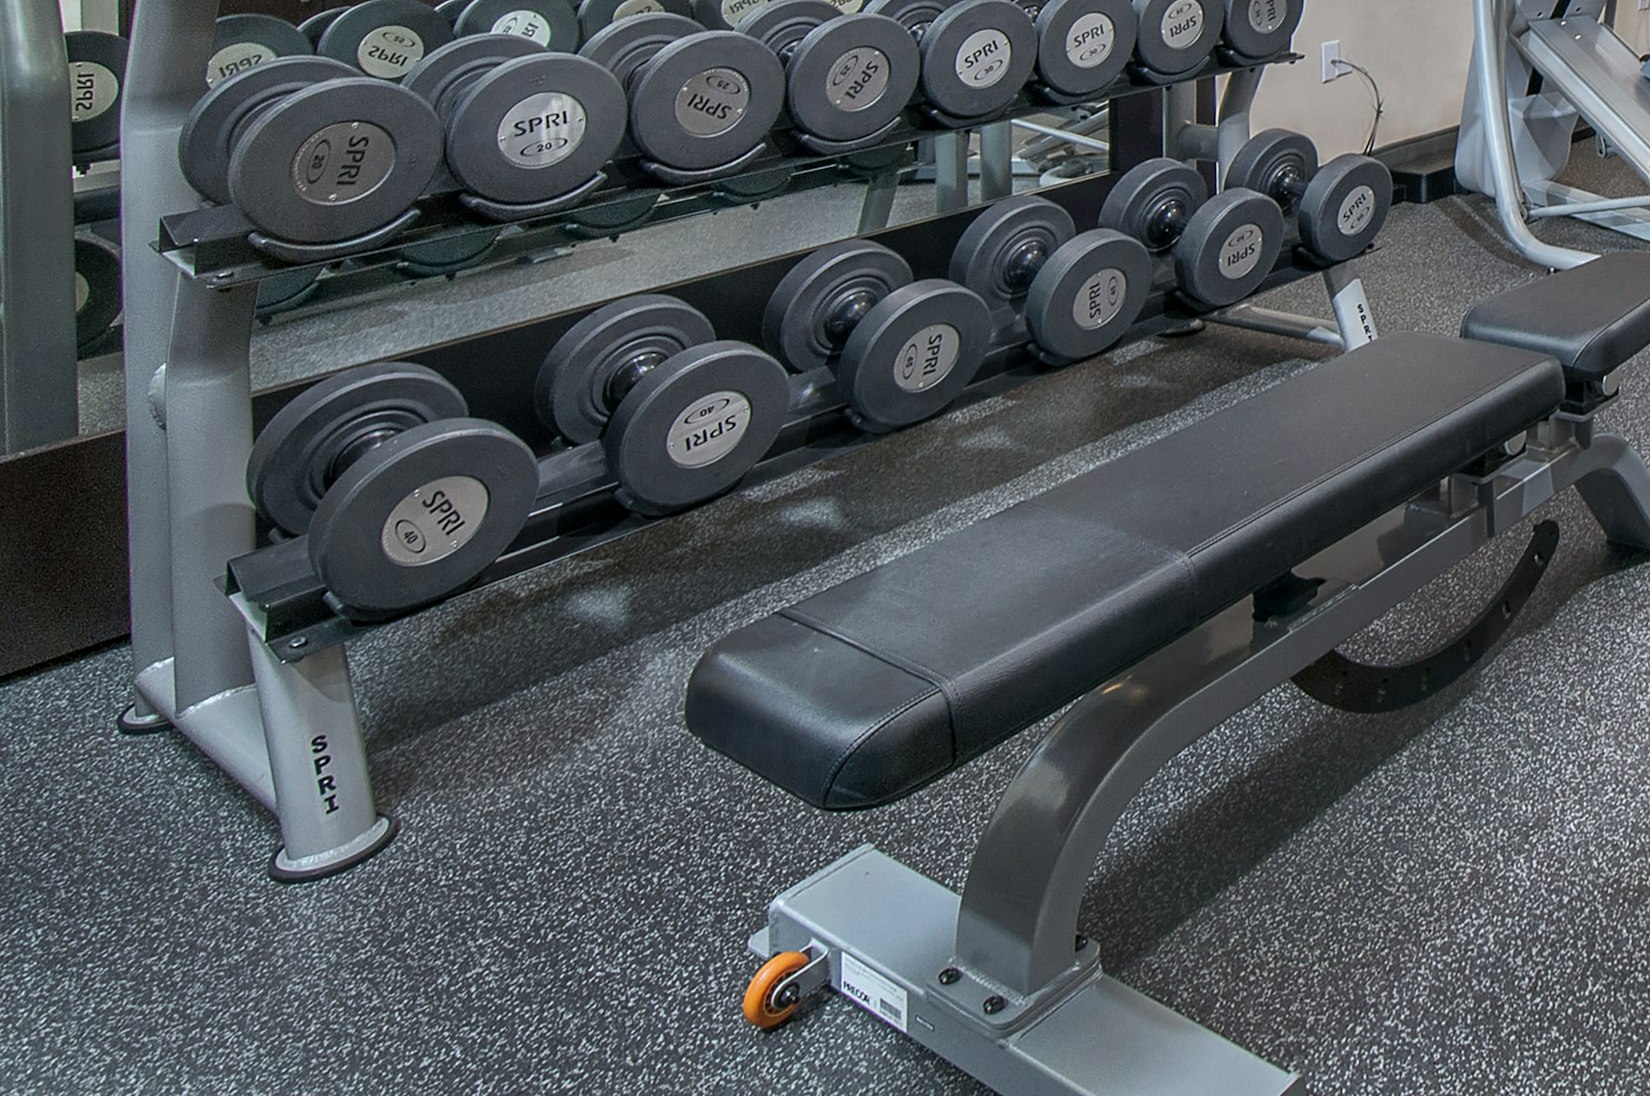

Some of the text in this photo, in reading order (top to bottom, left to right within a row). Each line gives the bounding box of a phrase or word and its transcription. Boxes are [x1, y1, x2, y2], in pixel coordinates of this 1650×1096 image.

[1073, 24, 1104, 48] SPRI
[1169, 15, 1197, 38] SPRI
[964, 39, 999, 68] SPRI
[715, 79, 729, 88] 25
[847, 60, 879, 101] SPRI
[687, 93, 732, 120] SPRI
[513, 110, 568, 137] SPRI
[336, 135, 369, 185] SPRI
[537, 142, 552, 152] 20
[1343, 193, 1367, 223] SPRI
[1227, 243, 1255, 267] SPRI
[1089, 283, 1101, 319] SPRI
[922, 333, 942, 377] SPRI
[699, 405, 715, 417] 40
[685, 414, 737, 452] SPRI
[422, 490, 465, 537] SPRI
[403, 529, 419, 544] 40
[311, 735, 339, 815] SPRI
